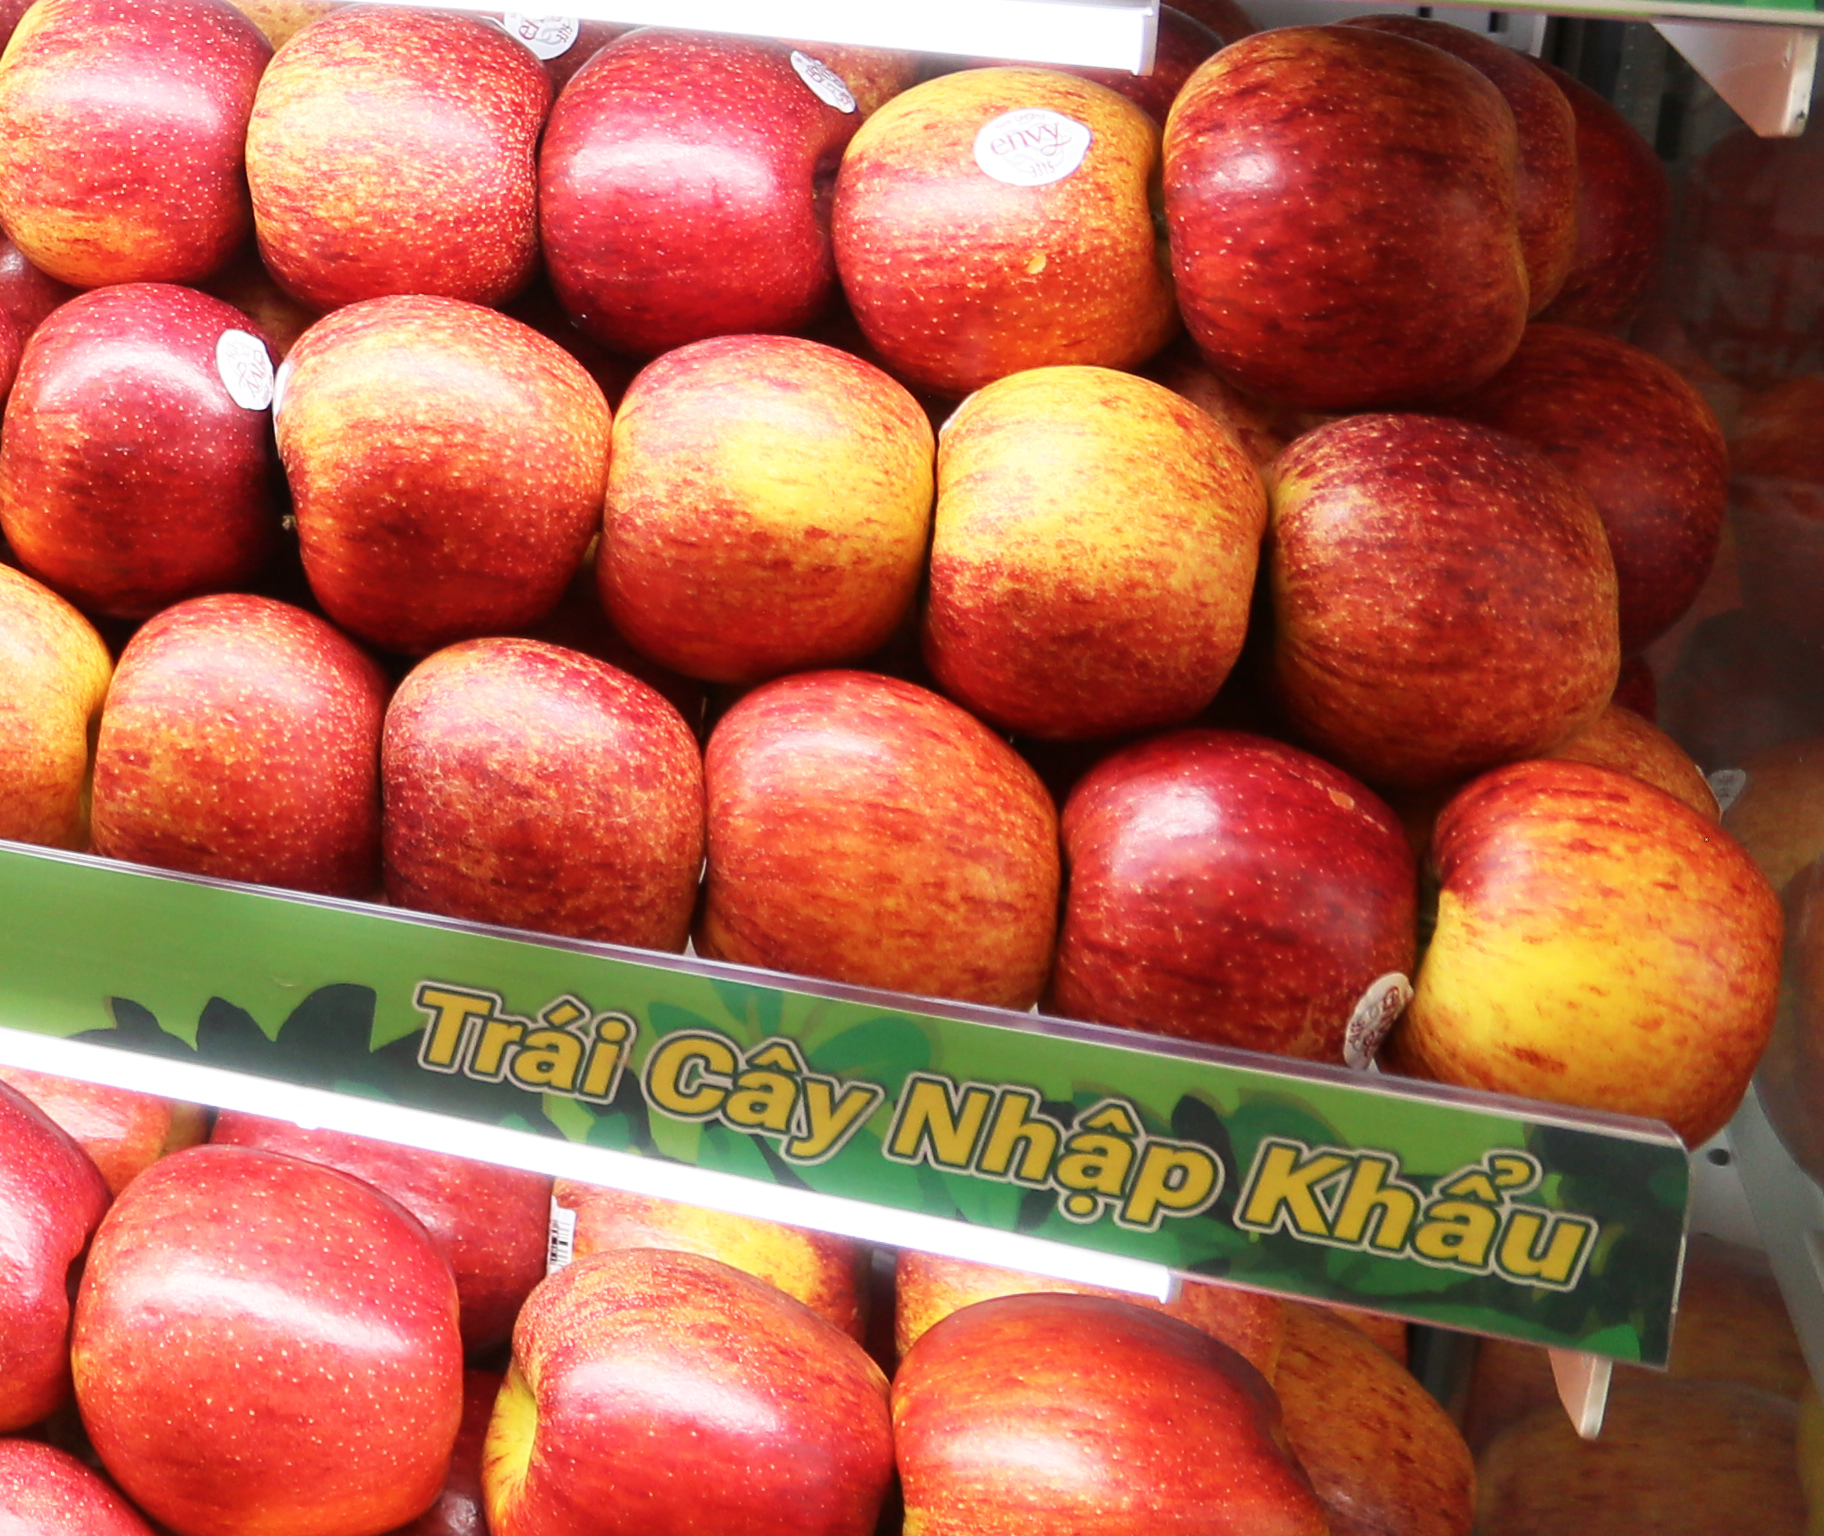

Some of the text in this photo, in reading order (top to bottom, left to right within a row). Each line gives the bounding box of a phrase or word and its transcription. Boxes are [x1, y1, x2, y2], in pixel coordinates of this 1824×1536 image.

[989, 120, 1073, 158] envy
[415, 977, 1598, 1295] Trái Cây Nhập Khẩu
